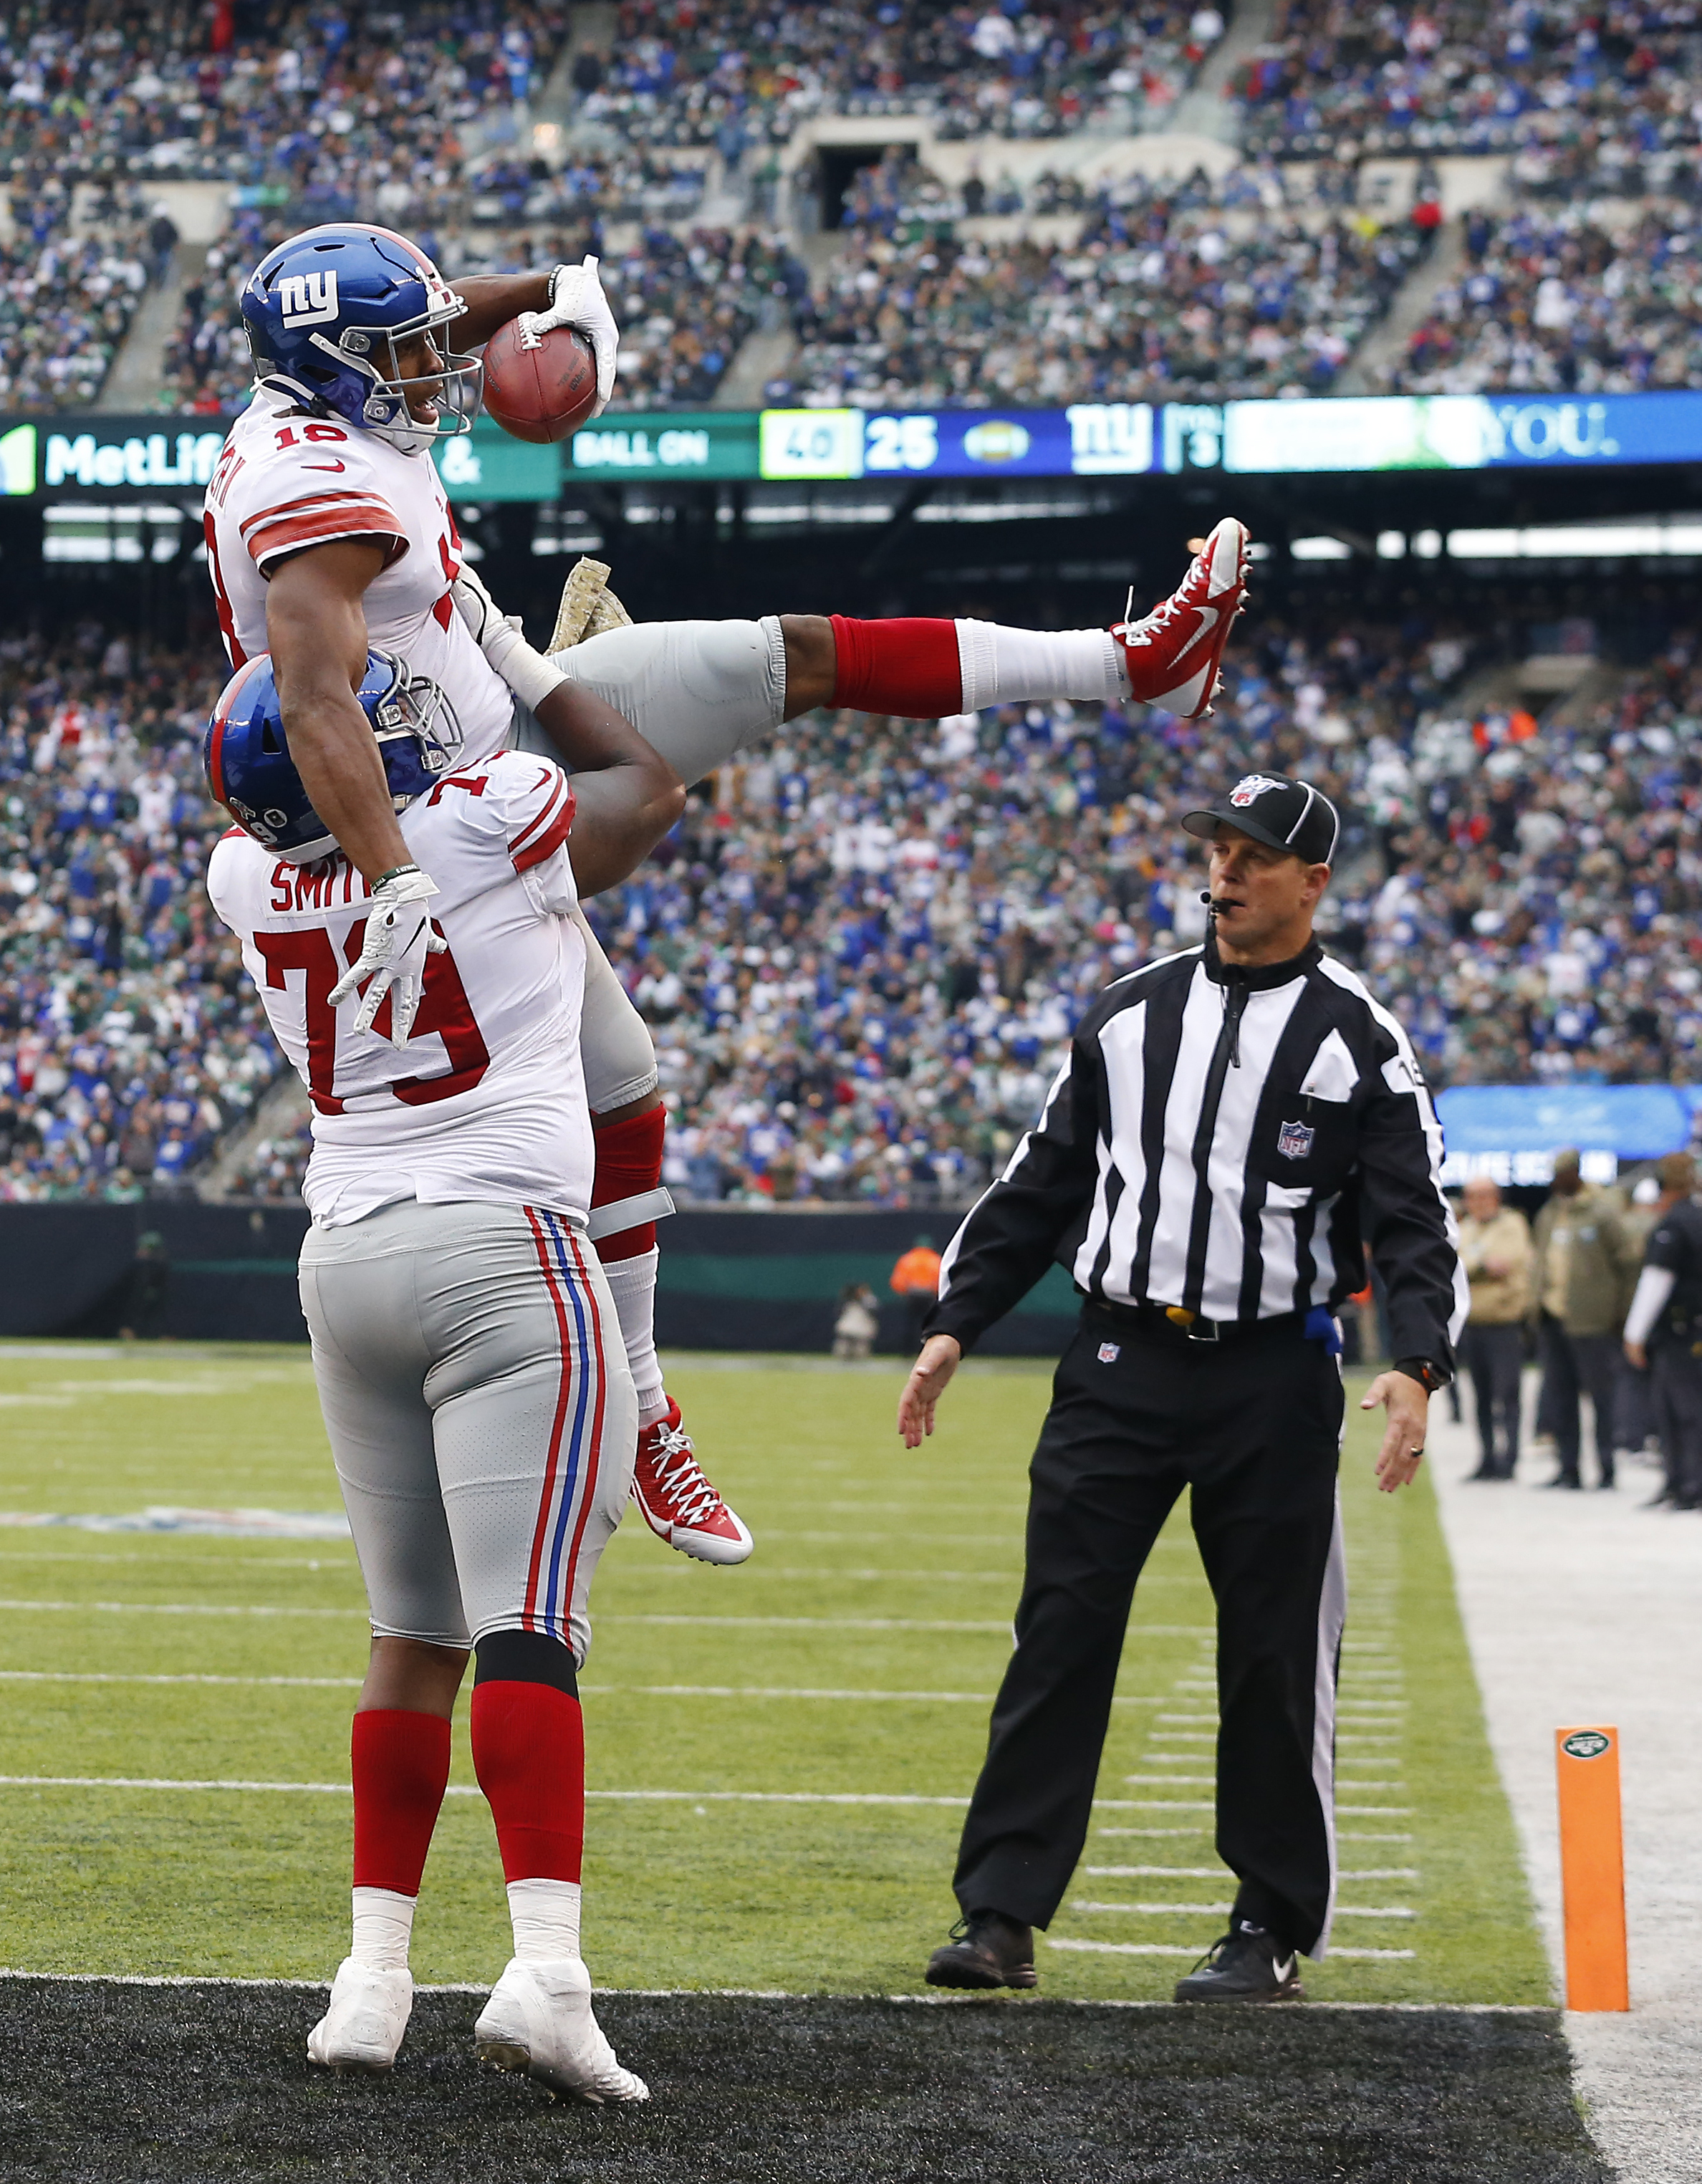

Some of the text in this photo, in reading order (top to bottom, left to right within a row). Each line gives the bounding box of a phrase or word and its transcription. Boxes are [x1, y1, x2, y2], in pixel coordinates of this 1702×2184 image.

[44, 433, 223, 486] MetLif
[441, 435, 482, 485] &
[574, 431, 709, 467] BALL ON
[785, 425, 834, 460] 40
[864, 416, 938, 469] 25
[252, 917, 491, 1117] 79
[1281, 1136, 1307, 1155] NFL
